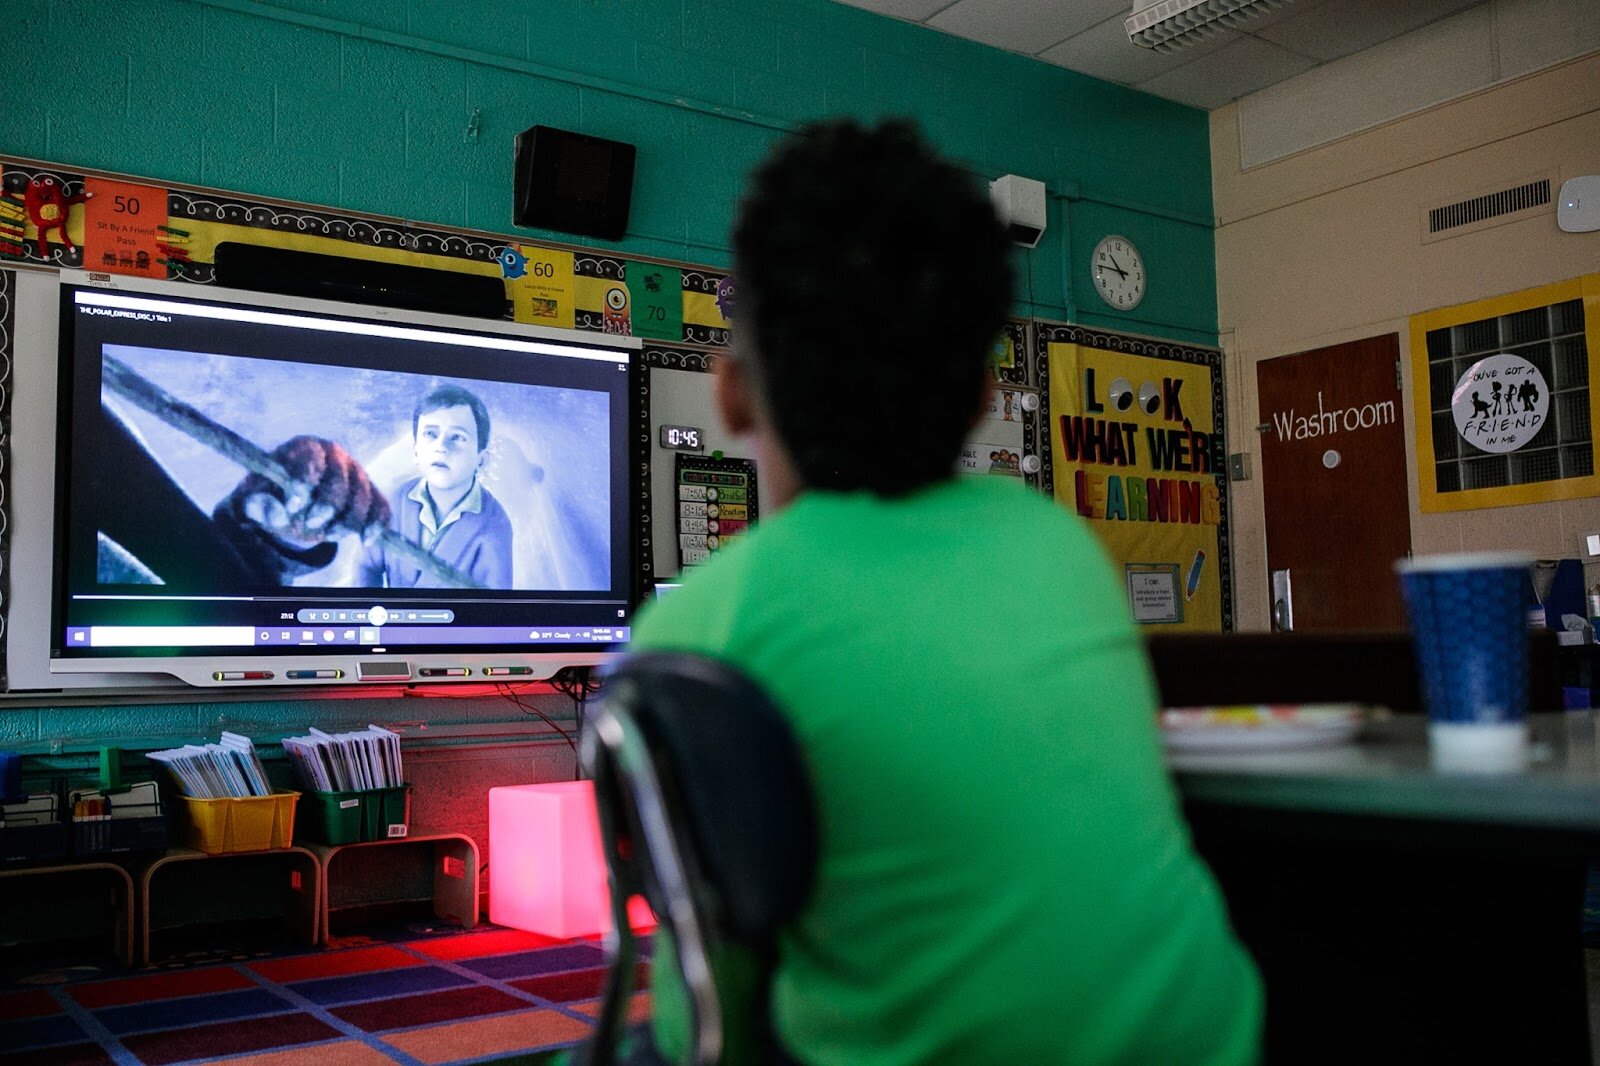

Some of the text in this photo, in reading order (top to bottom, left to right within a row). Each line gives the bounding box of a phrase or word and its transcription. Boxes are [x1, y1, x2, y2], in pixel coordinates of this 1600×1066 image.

[114, 196, 140, 215] 50
[97, 222, 108, 230] Sit
[110, 224, 120, 232] By
[129, 226, 155, 235] Friend
[117, 236, 136, 246] Pass
[1106, 244, 1112, 252] 11
[1115, 242, 1121, 251] 12
[1100, 252, 1106, 261] 10
[1133, 258, 1137, 267] 2
[534, 262, 554, 278] 60
[1099, 266, 1102, 274] 9
[1137, 272, 1140, 280] 3
[1102, 280, 1106, 288] 8
[1110, 290, 1113, 298] 7
[1134, 286, 1138, 294] 4
[1119, 296, 1122, 304] 6
[1128, 293, 1132, 301] 5
[647, 306, 666, 321] 70
[1504, 366, 1524, 376] GOT
[1526, 367, 1536, 375] A
[1273, 392, 1396, 443] Washroom
[668, 429, 698, 448] 10:45
[1059, 414, 1138, 466] WHAT
[1486, 434, 1518, 445] IN ME
[1075, 470, 1220, 524] LEARNING
[720, 504, 746, 518] Reading
[554, 632, 572, 640] Cloudy
